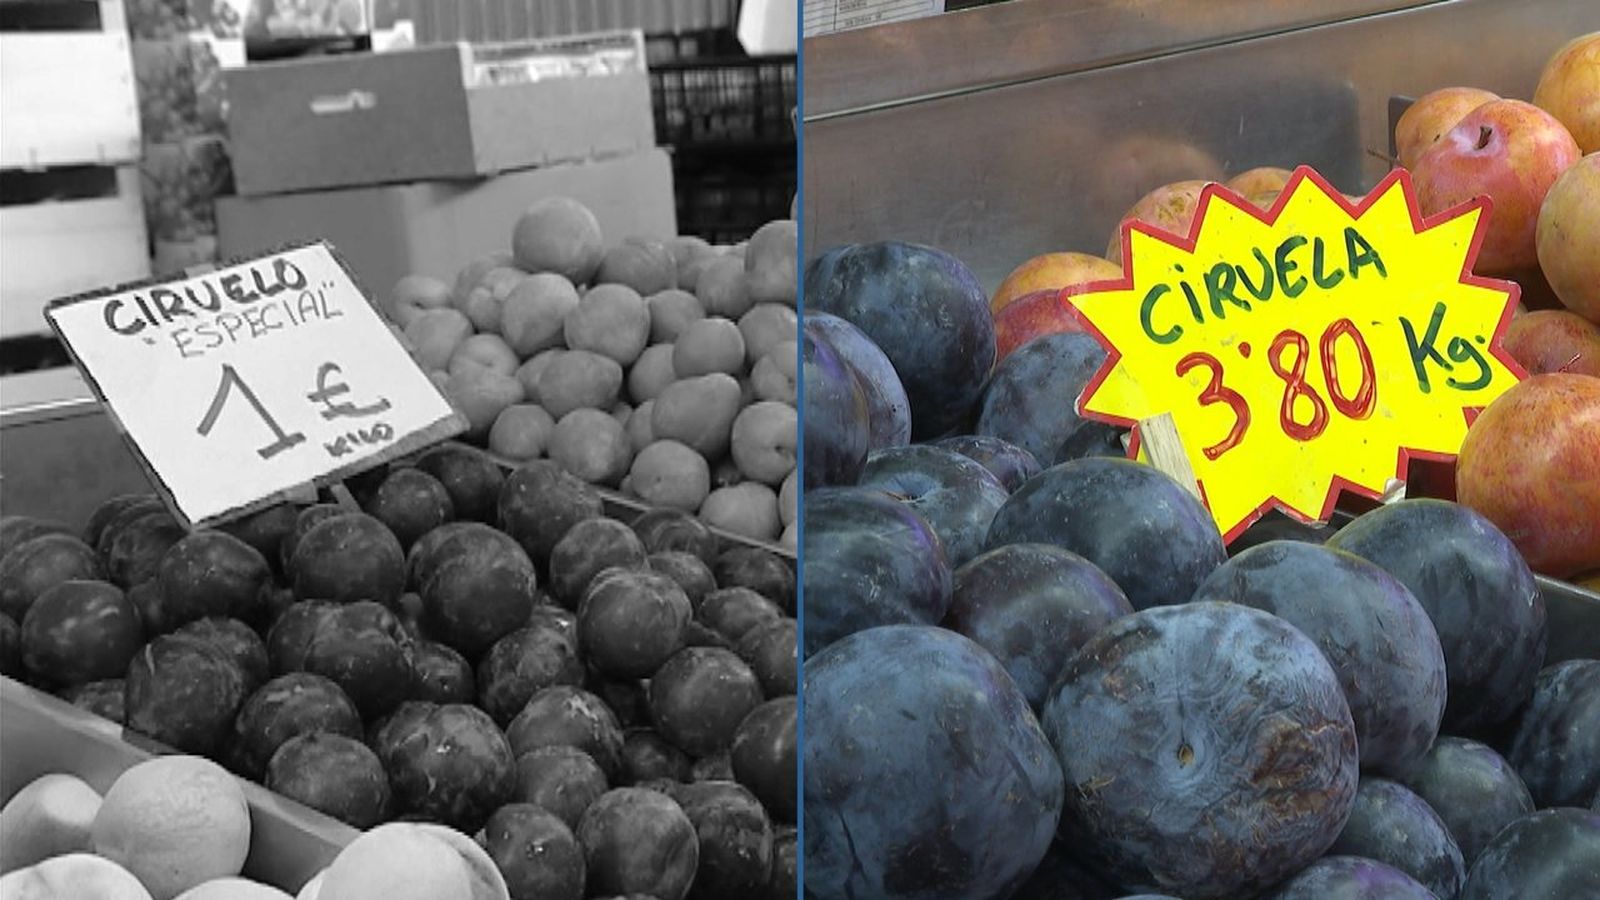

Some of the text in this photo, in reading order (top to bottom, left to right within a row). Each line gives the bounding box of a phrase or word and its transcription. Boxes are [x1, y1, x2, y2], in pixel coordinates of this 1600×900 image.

[104, 259, 307, 335] CIRUELO
[197, 364, 305, 459] 1
[1175, 318, 1377, 460] 3'80
